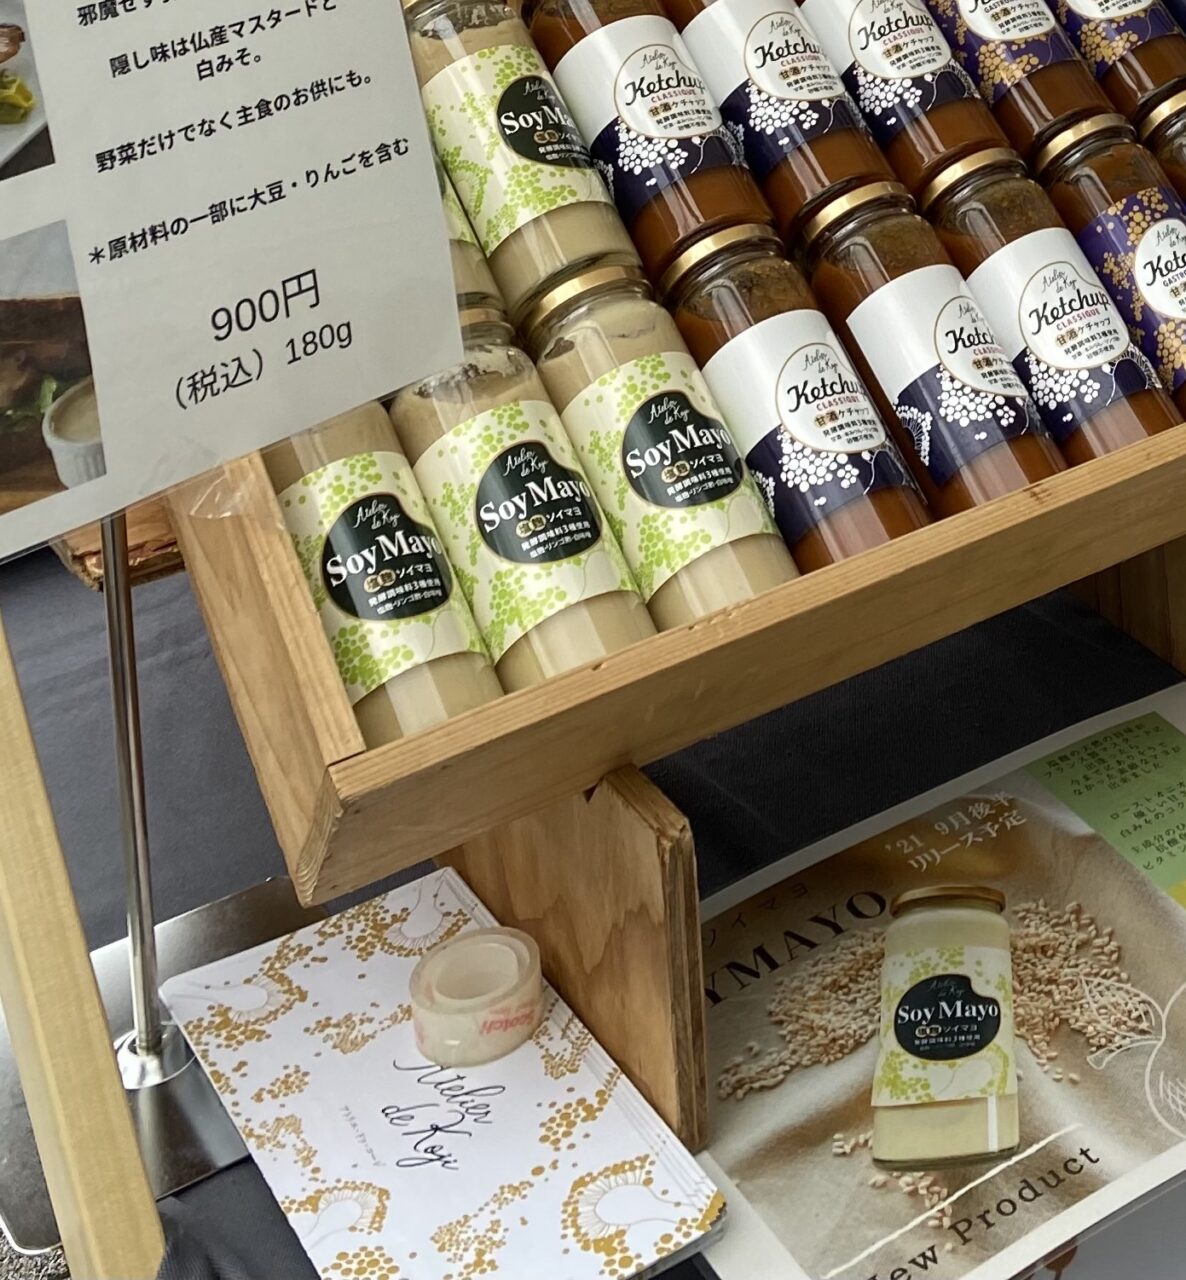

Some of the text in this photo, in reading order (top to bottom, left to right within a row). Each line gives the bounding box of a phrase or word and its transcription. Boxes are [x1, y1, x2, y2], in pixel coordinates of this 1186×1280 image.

[196, 52, 263, 81] 白みそ。
[96, 70, 372, 173] 野菜だけでなく主食のお供にも。
[211, 269, 321, 342] 900円
[1029, 289, 1111, 335] Ketchup
[285, 321, 353, 365] 180g
[949, 1146, 1100, 1246] Product
